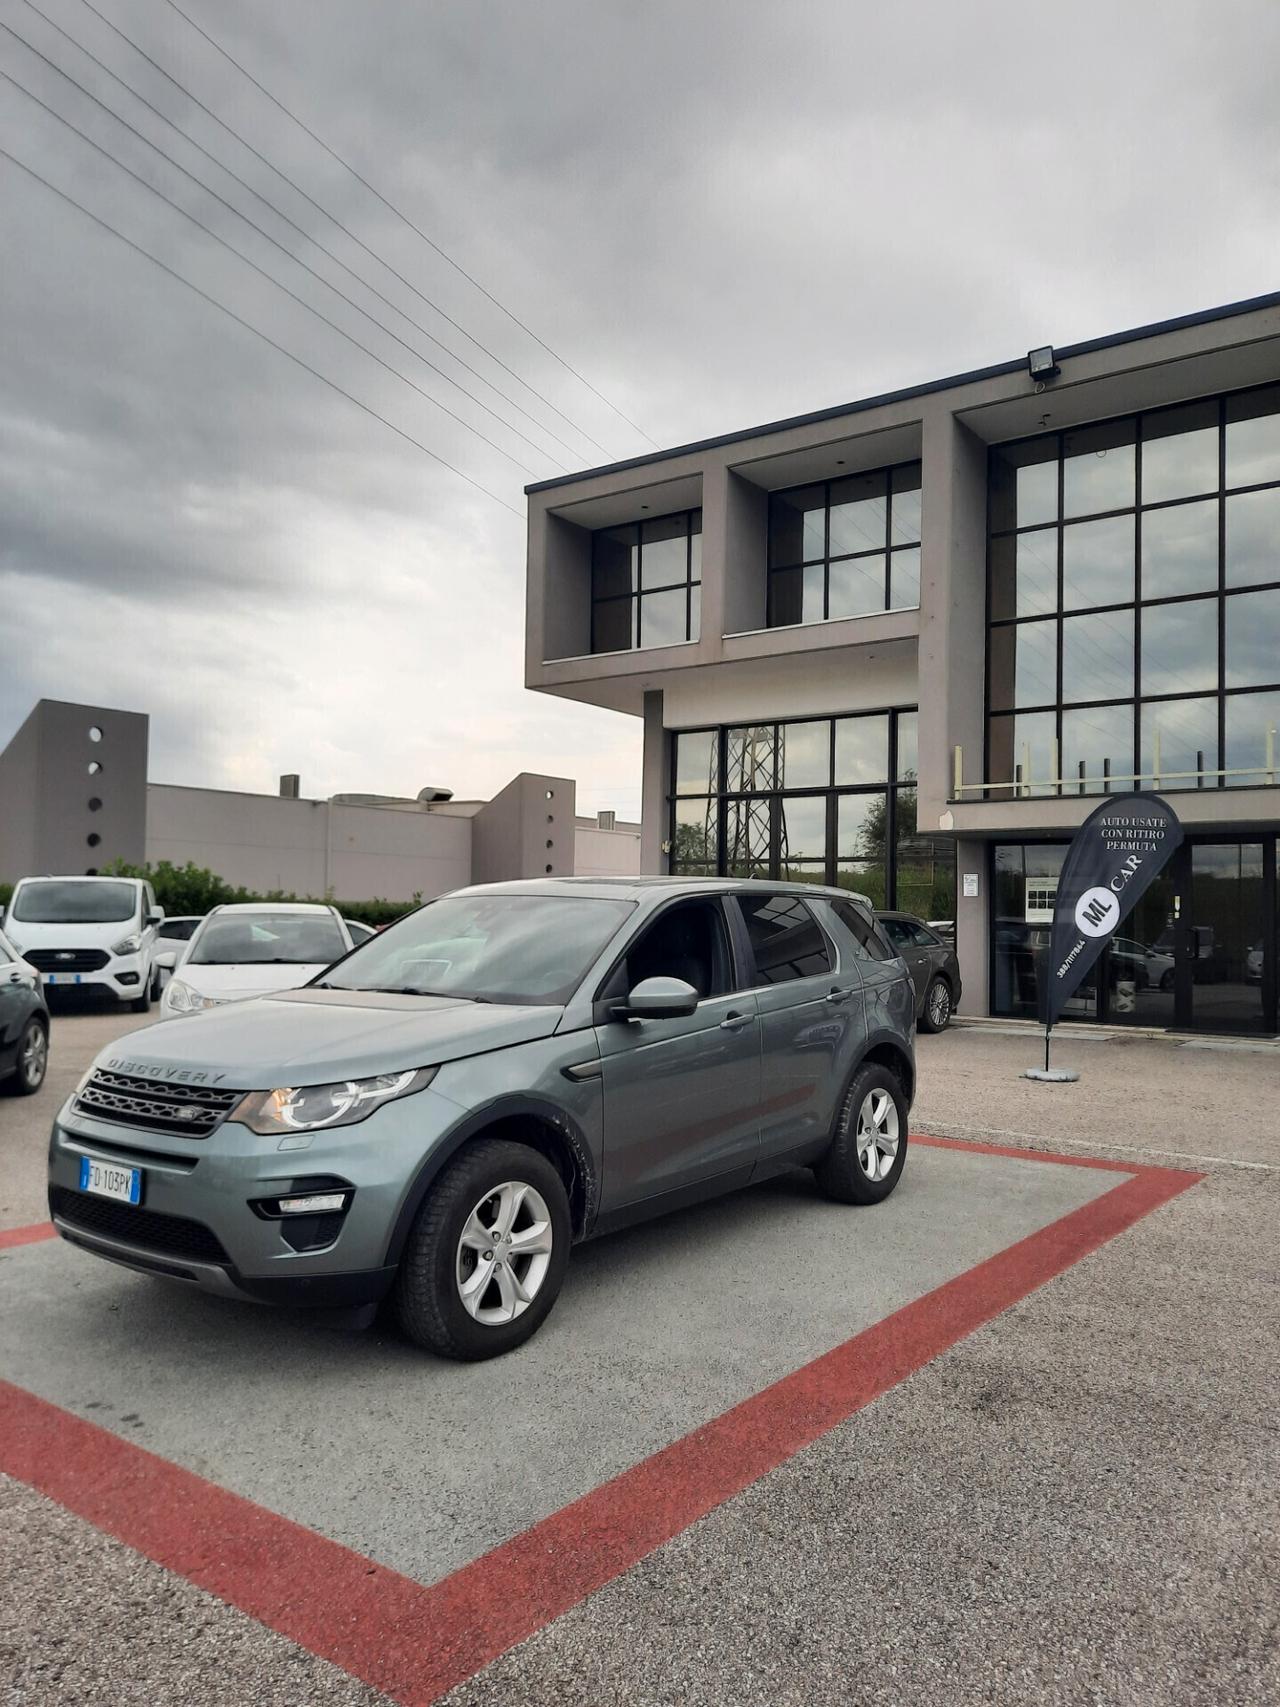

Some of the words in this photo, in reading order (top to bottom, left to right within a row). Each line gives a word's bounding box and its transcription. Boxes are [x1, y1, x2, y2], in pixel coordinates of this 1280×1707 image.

[1100, 817, 1130, 826] AUTO
[1132, 817, 1167, 828] USATE
[1101, 829, 1123, 838] CON
[1126, 829, 1165, 839] RITIRO
[1106, 841, 1157, 851] PERMUTA
[1082, 898, 1112, 928] ML
[1110, 854, 1143, 892] CAR
[108, 1058, 227, 1084] DISCOVERY
